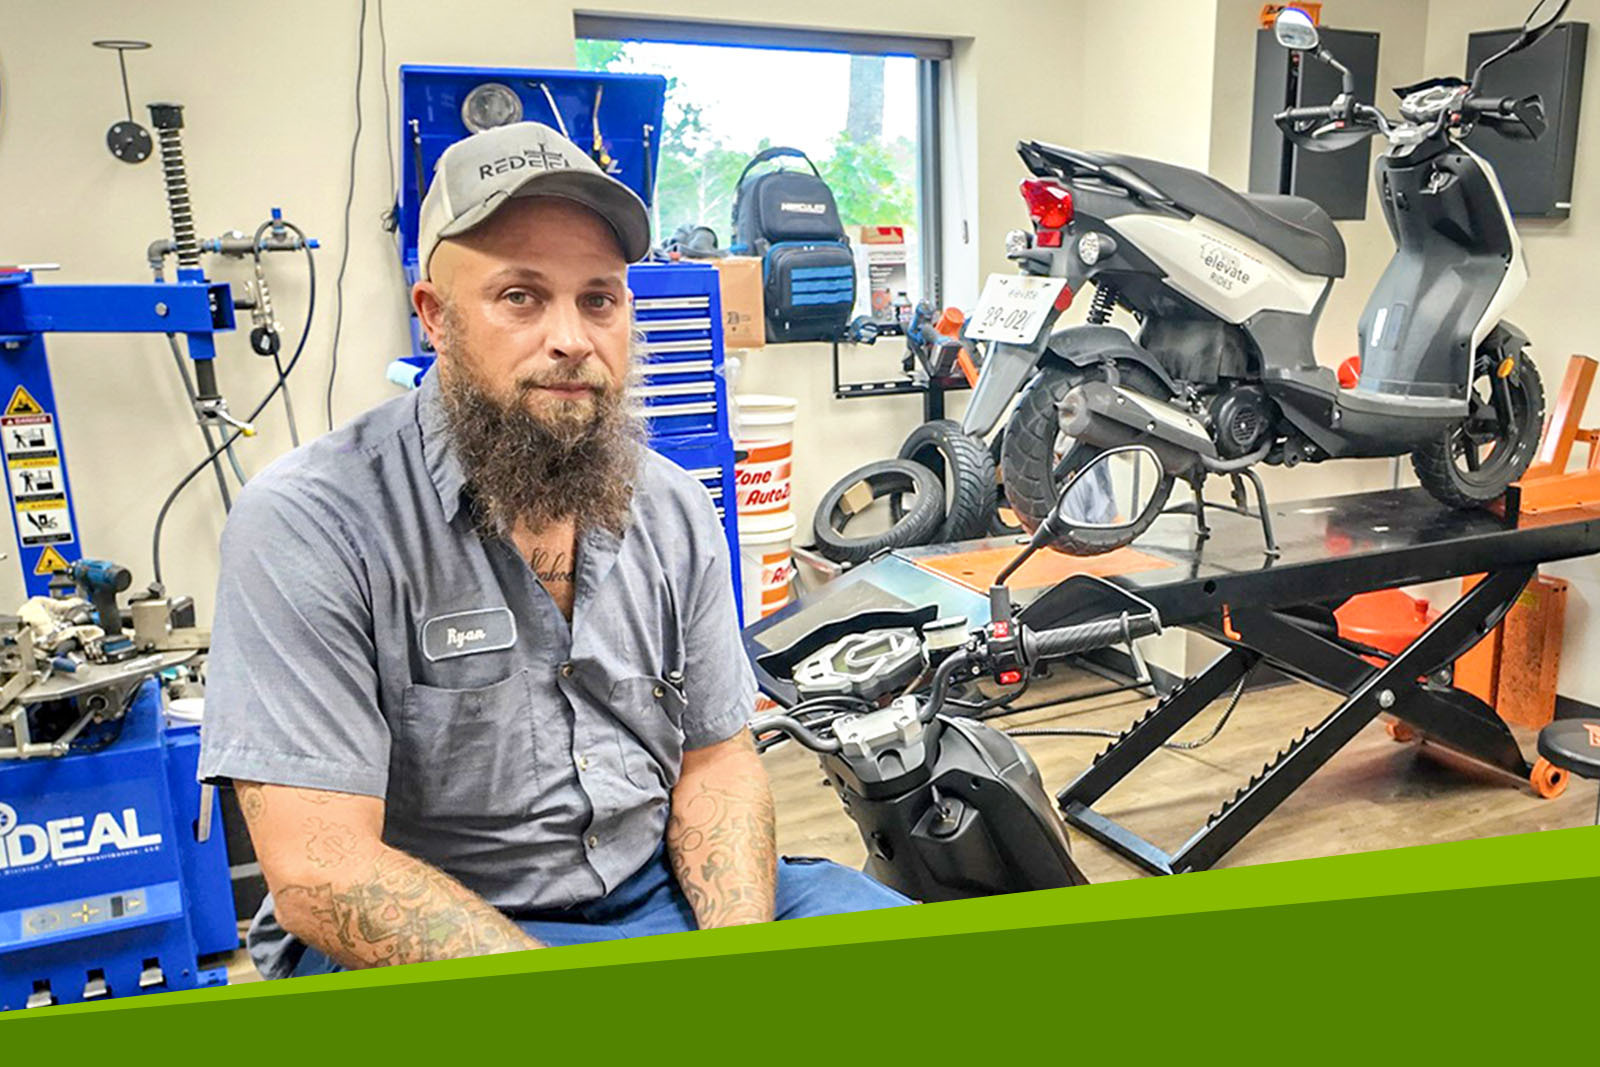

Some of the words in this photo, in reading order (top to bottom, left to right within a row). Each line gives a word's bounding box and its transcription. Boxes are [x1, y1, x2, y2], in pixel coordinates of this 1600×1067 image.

[1205, 253, 1250, 284] elevate
[1210, 271, 1234, 290] RIDES
[447, 627, 487, 649] Ryan
